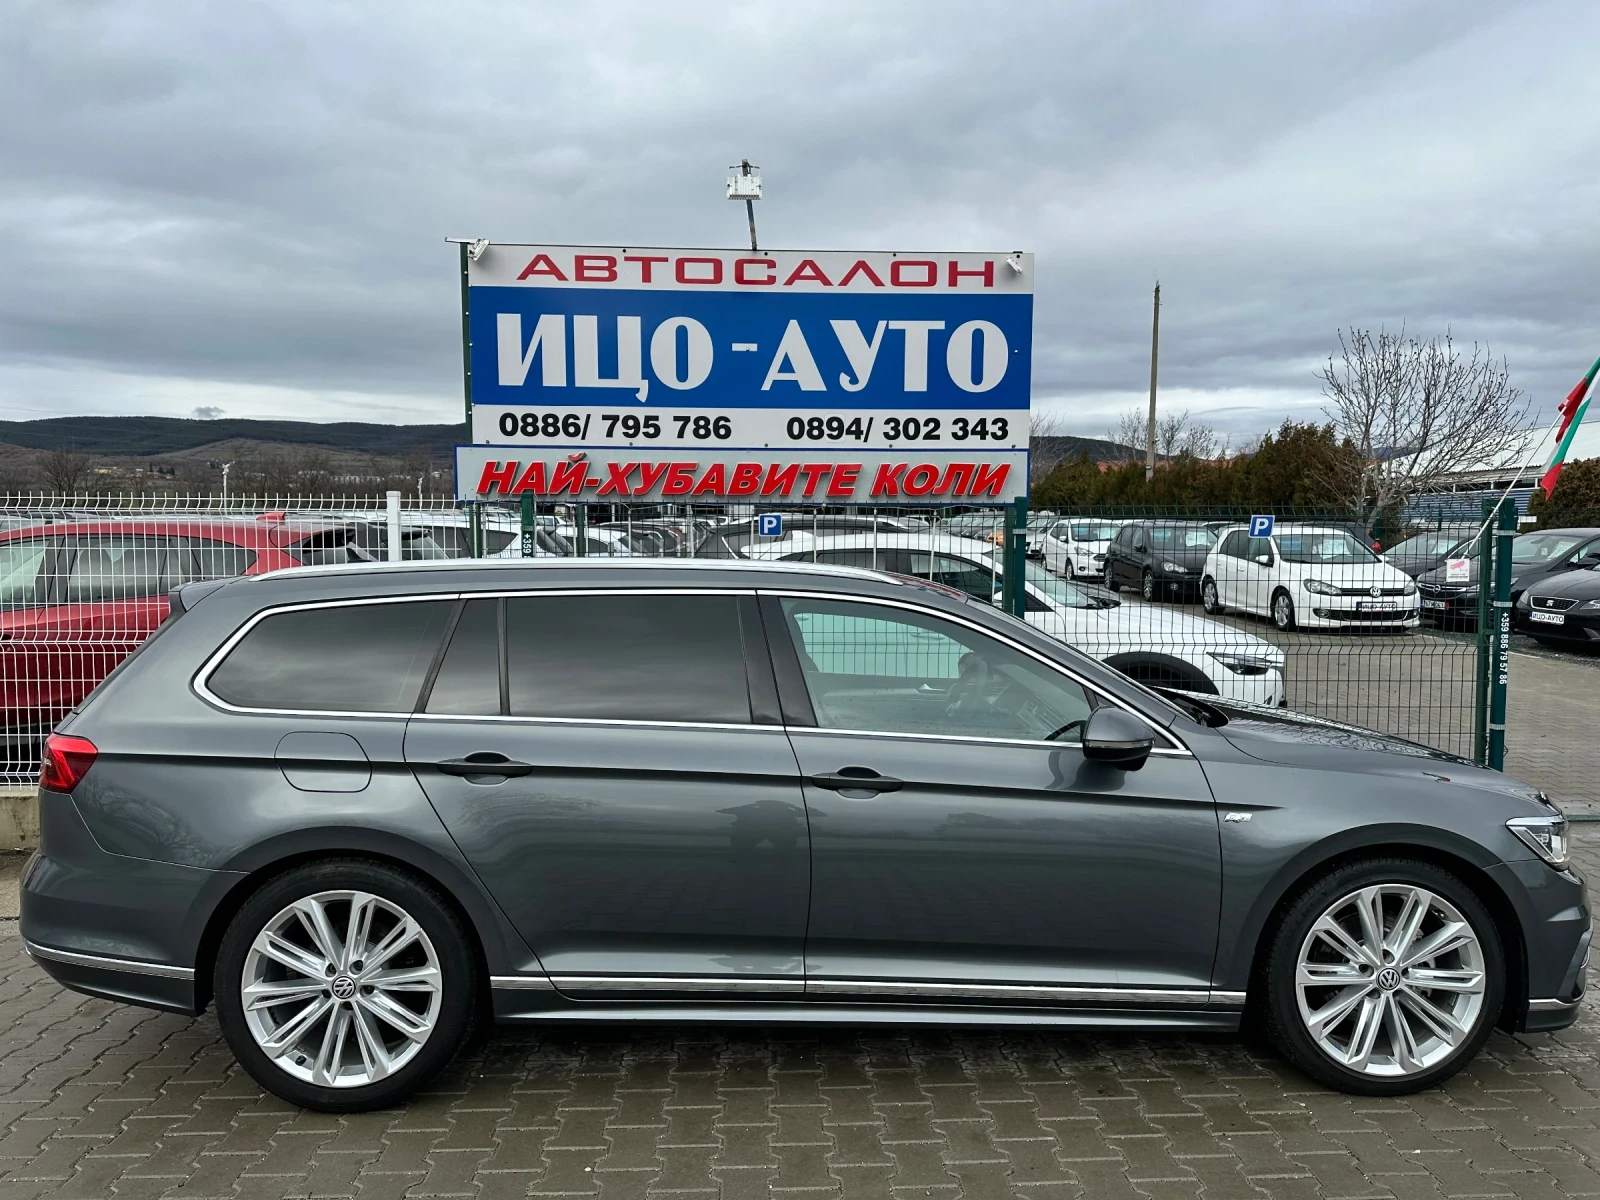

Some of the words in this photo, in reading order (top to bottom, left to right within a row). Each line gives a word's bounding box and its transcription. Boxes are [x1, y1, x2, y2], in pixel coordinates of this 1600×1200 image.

[516, 253, 994, 287] АВТОСАЛОН
[499, 413, 591, 441] 0886/
[604, 415, 661, 438] 795
[673, 416, 732, 440] 786
[786, 417, 874, 442] 0894/
[883, 418, 941, 441] 302
[952, 418, 1009, 441] 343
[476, 452, 863, 497] НАЙ-ХУБАВИТЕ
[870, 463, 1012, 497] КОЛИ
[763, 516, 777, 534] P
[1253, 518, 1269, 535] P
[523, 533, 532, 554] +359
[1501, 612, 1510, 632] +359
[1532, 612, 1564, 623] ИЦО-АУТО
[1500, 634, 1509, 649] 886
[1500, 650, 1508, 661] 79
[1499, 662, 1508, 672] 57
[1499, 674, 1507, 685] 86
